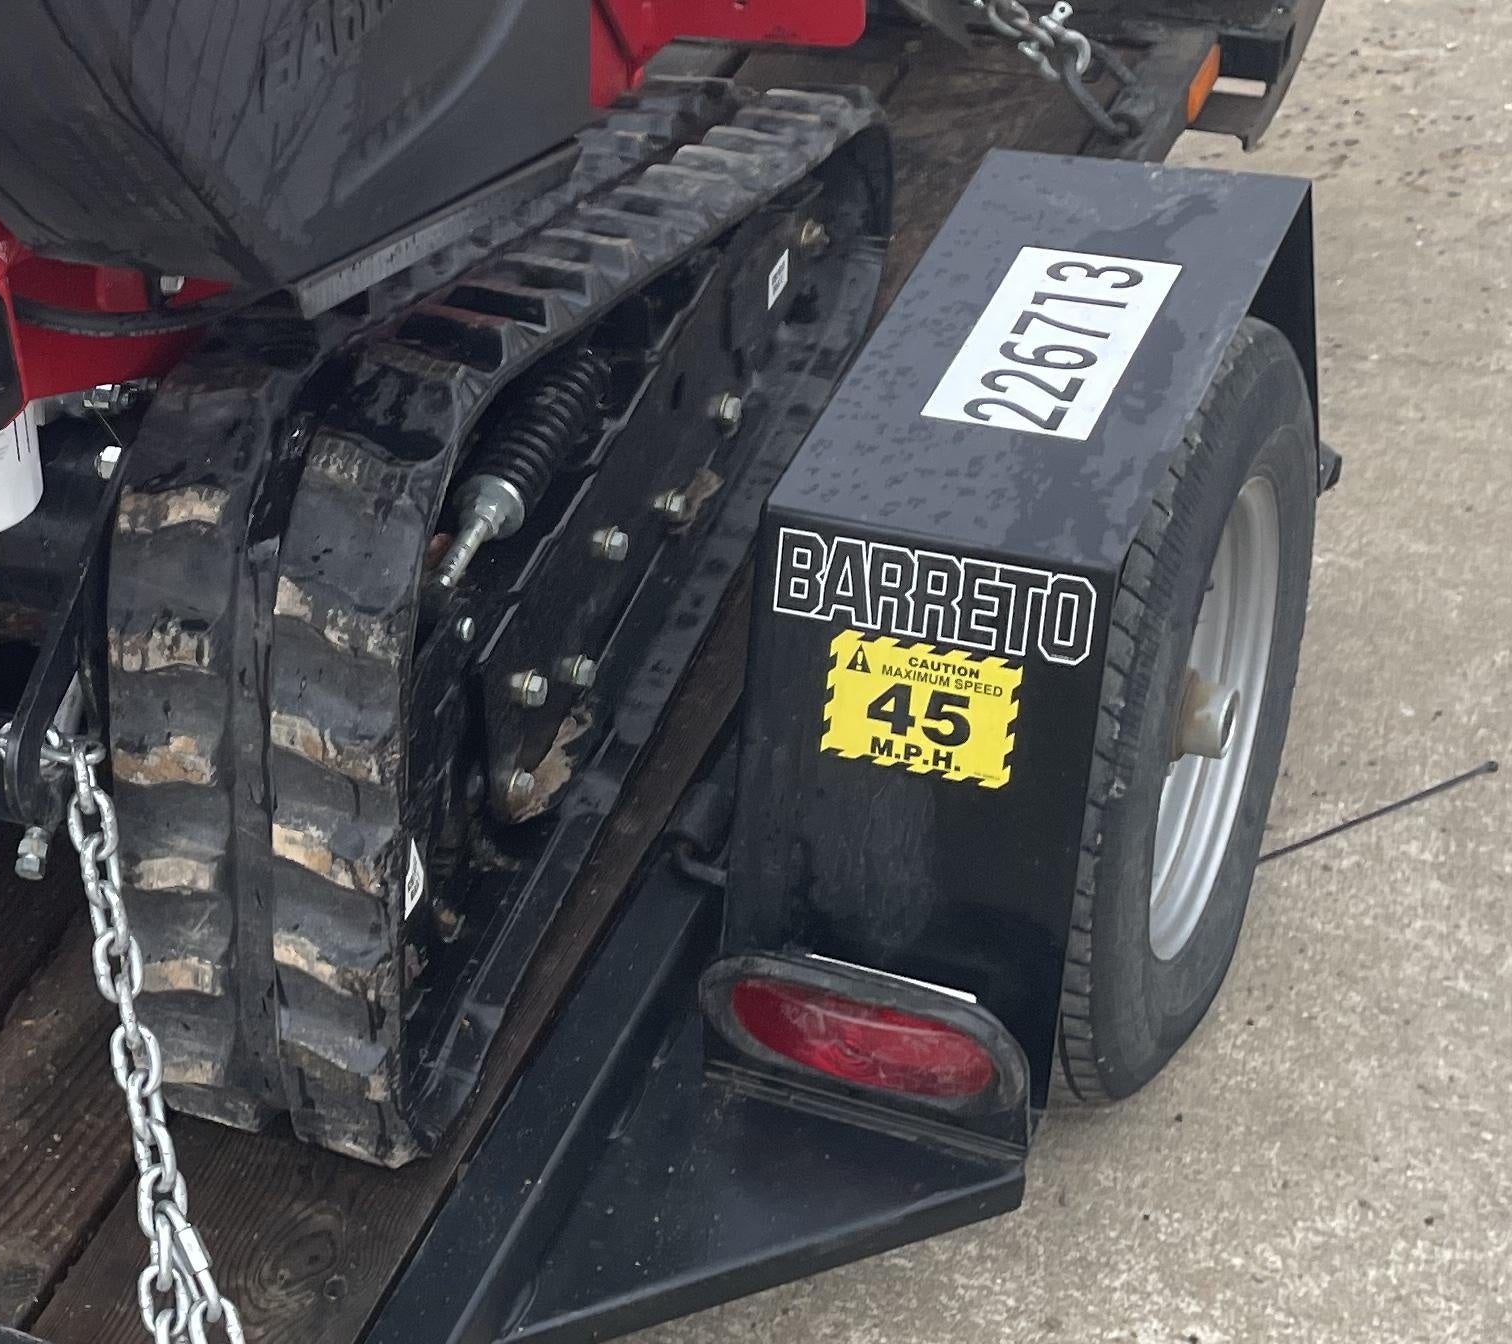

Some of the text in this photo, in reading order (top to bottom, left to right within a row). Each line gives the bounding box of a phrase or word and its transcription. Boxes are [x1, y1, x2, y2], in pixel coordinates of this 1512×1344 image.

[962, 259, 1145, 432] 226713
[772, 526, 1098, 667] BARRETO
[880, 663, 1004, 699] MAXIMUM SPEED
[908, 655, 981, 680] CAUTION
[866, 682, 972, 748] 45
[869, 735, 962, 773] M.P.H.
